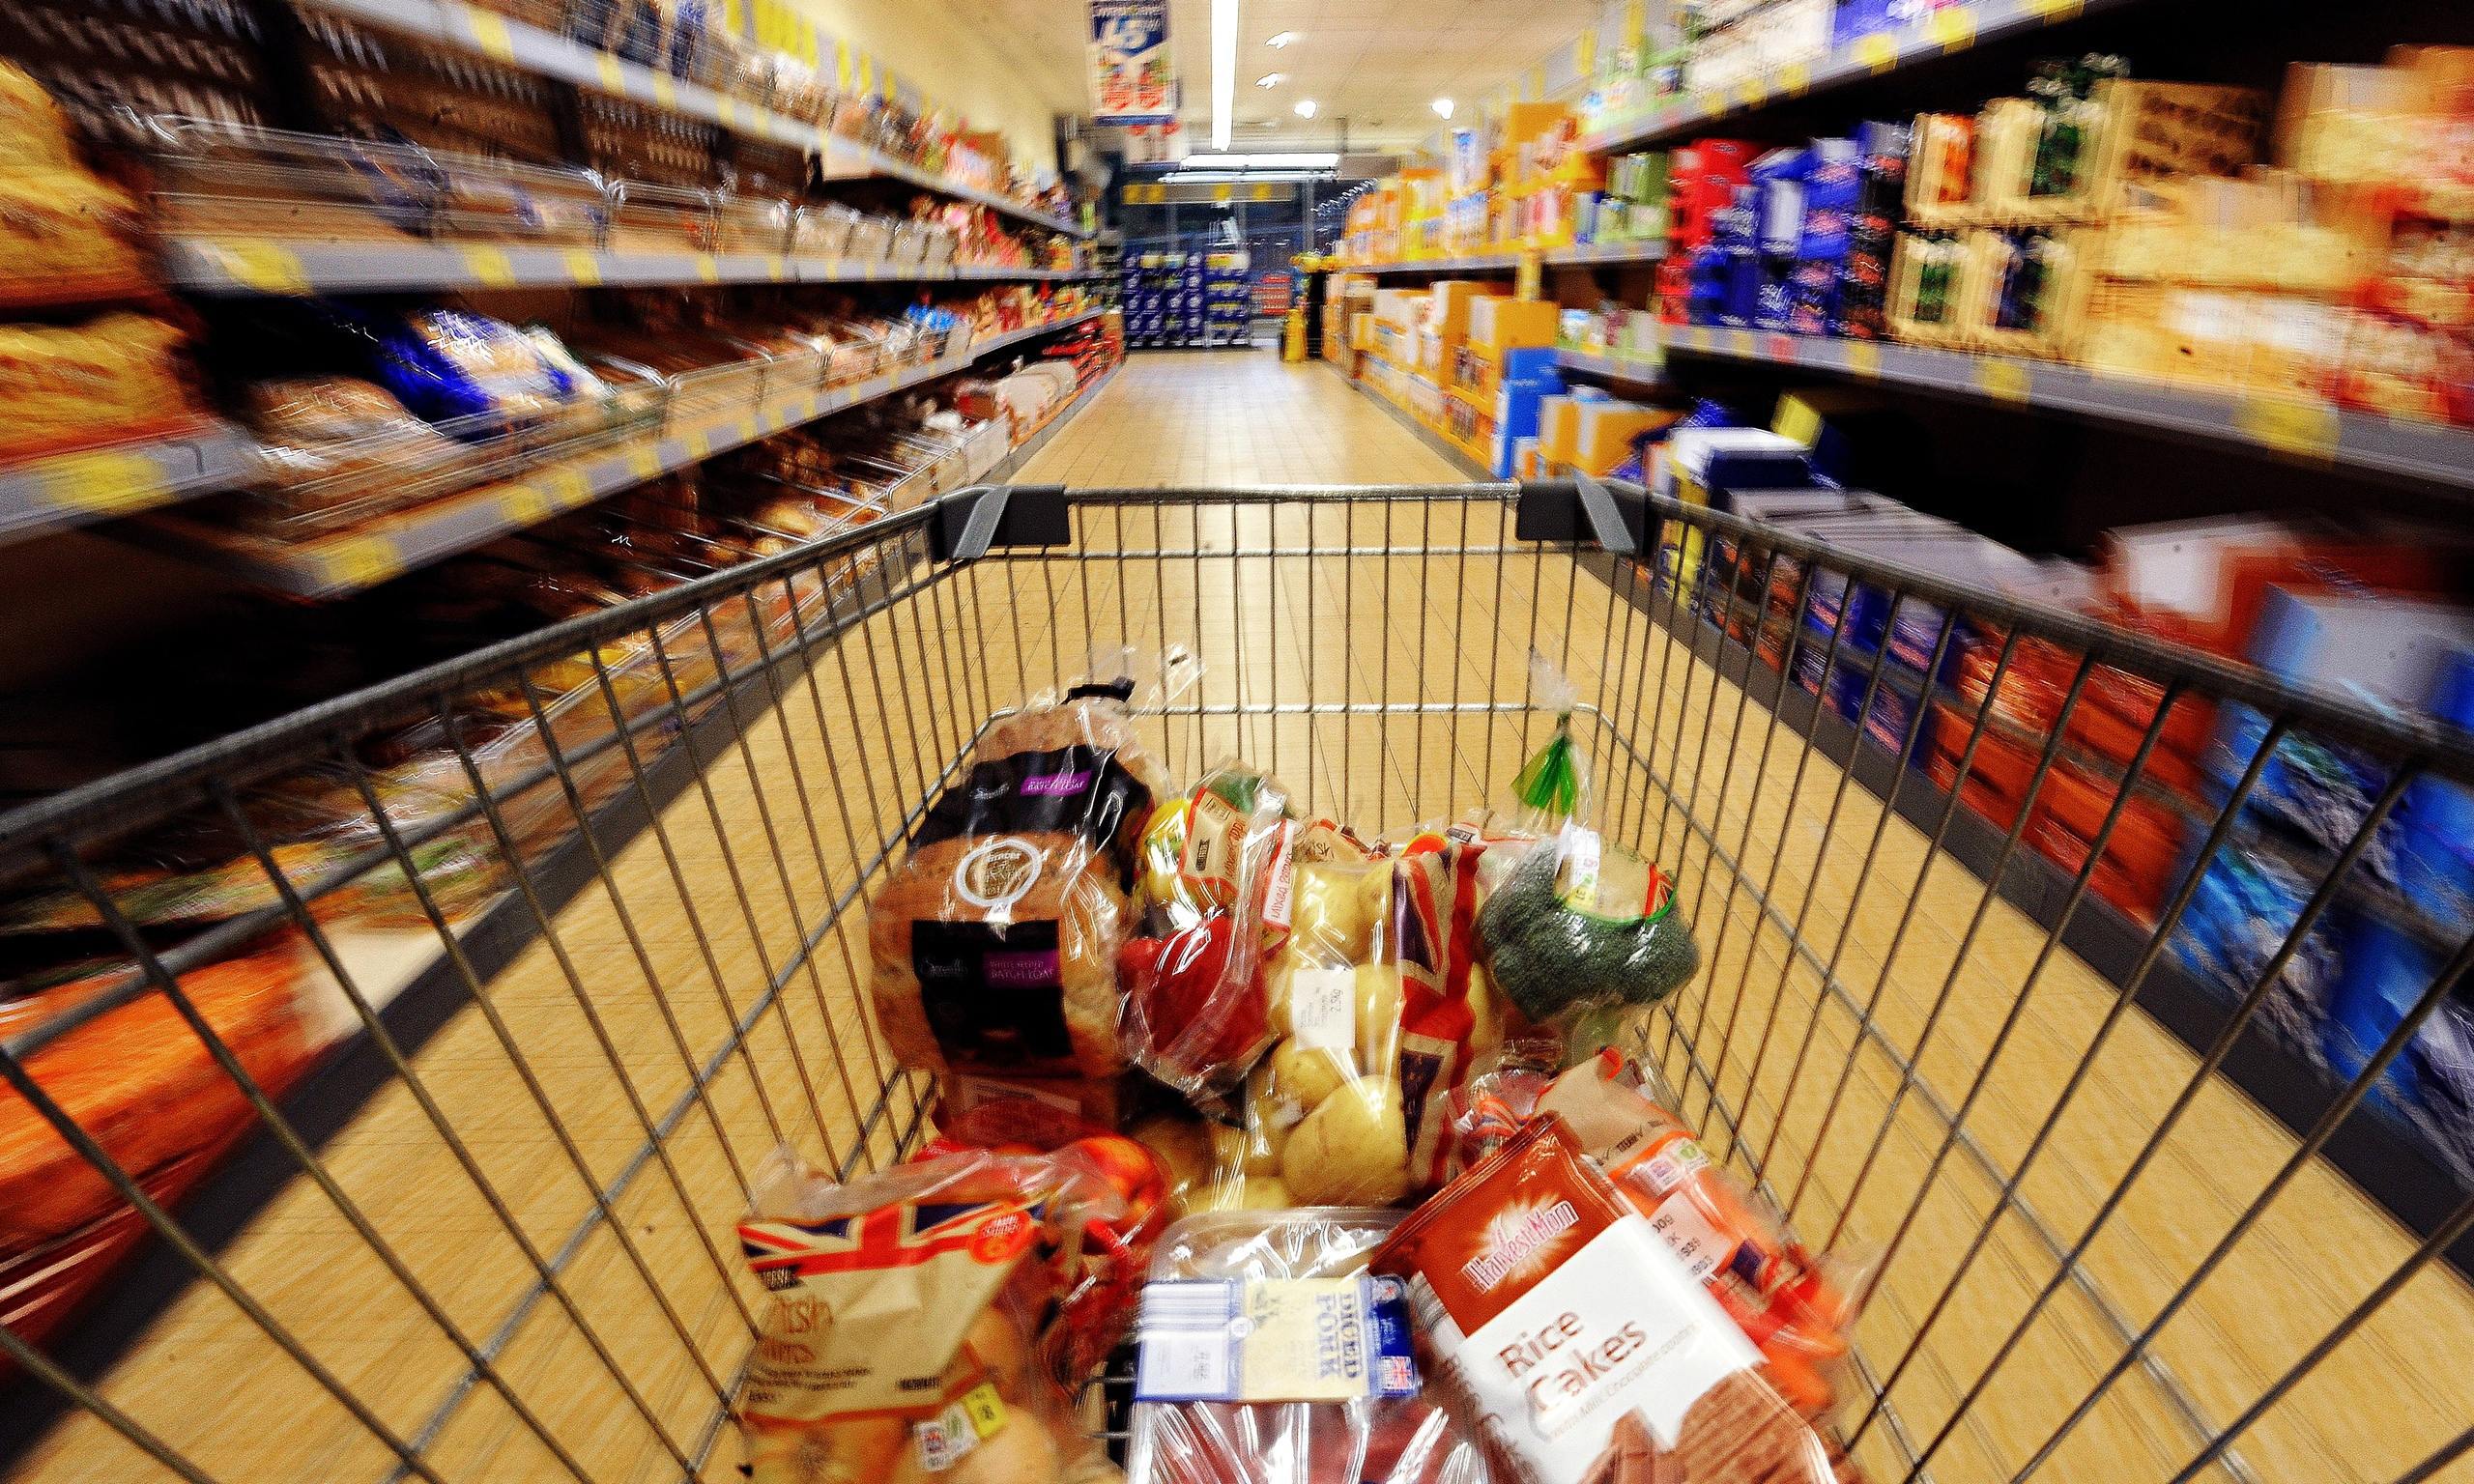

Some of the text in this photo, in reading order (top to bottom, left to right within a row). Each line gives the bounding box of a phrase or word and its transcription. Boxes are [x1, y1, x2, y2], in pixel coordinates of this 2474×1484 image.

[1316, 1294, 1341, 1379] PORK
[1339, 1293, 1362, 1379] DICED
[1498, 1311, 1585, 1379] Rice
[1525, 1320, 1647, 1412] Cakes
